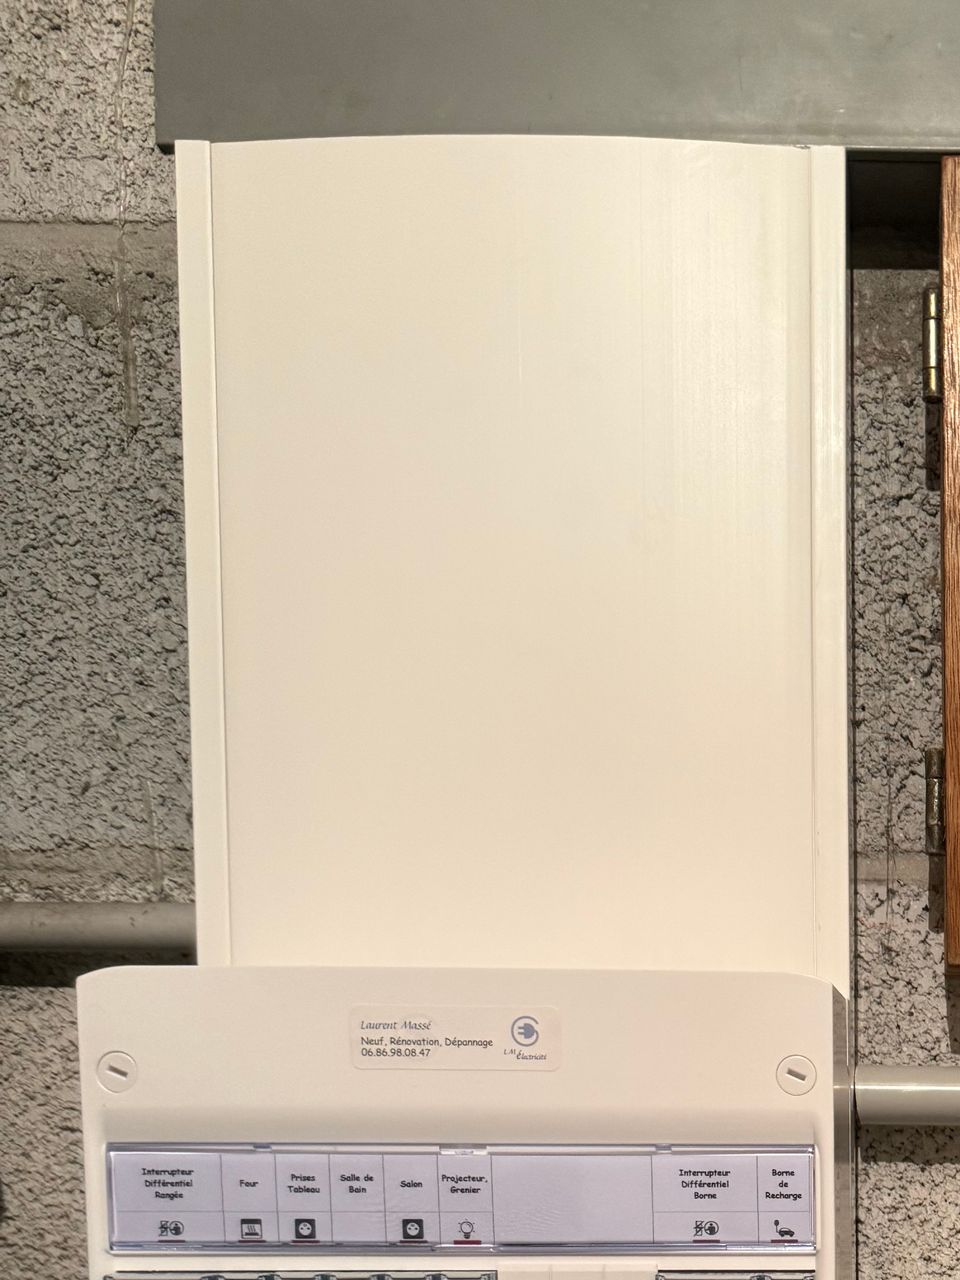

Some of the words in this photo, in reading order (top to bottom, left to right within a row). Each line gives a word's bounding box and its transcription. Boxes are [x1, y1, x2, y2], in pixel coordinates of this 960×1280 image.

[360, 1020, 397, 1030] Laurent
[400, 1020, 432, 1030] Massé
[361, 1037, 387, 1047] Neuf,
[389, 1036, 442, 1047] Rénovation,
[444, 1037, 493, 1048] Dépannage
[361, 1048, 431, 1057] 06.86.98.08.47
[142, 1168, 194, 1177] Interrupteur
[679, 1169, 730, 1178] Interrupteur
[772, 1169, 795, 1177] Borne
[291, 1173, 315, 1181] Prises
[340, 1174, 361, 1182] Salle
[364, 1174, 374, 1182] de
[441, 1174, 488, 1183] Projecteur,
[400, 1180, 423, 1188] Salon
[681, 1180, 729, 1188] Différentiel
[779, 1180, 788, 1188] de
[288, 1185, 320, 1193] Tableau
[450, 1186, 481, 1194] Grenier
[155, 1191, 183, 1200] Rangée
[765, 1192, 802, 1201] Recharge
